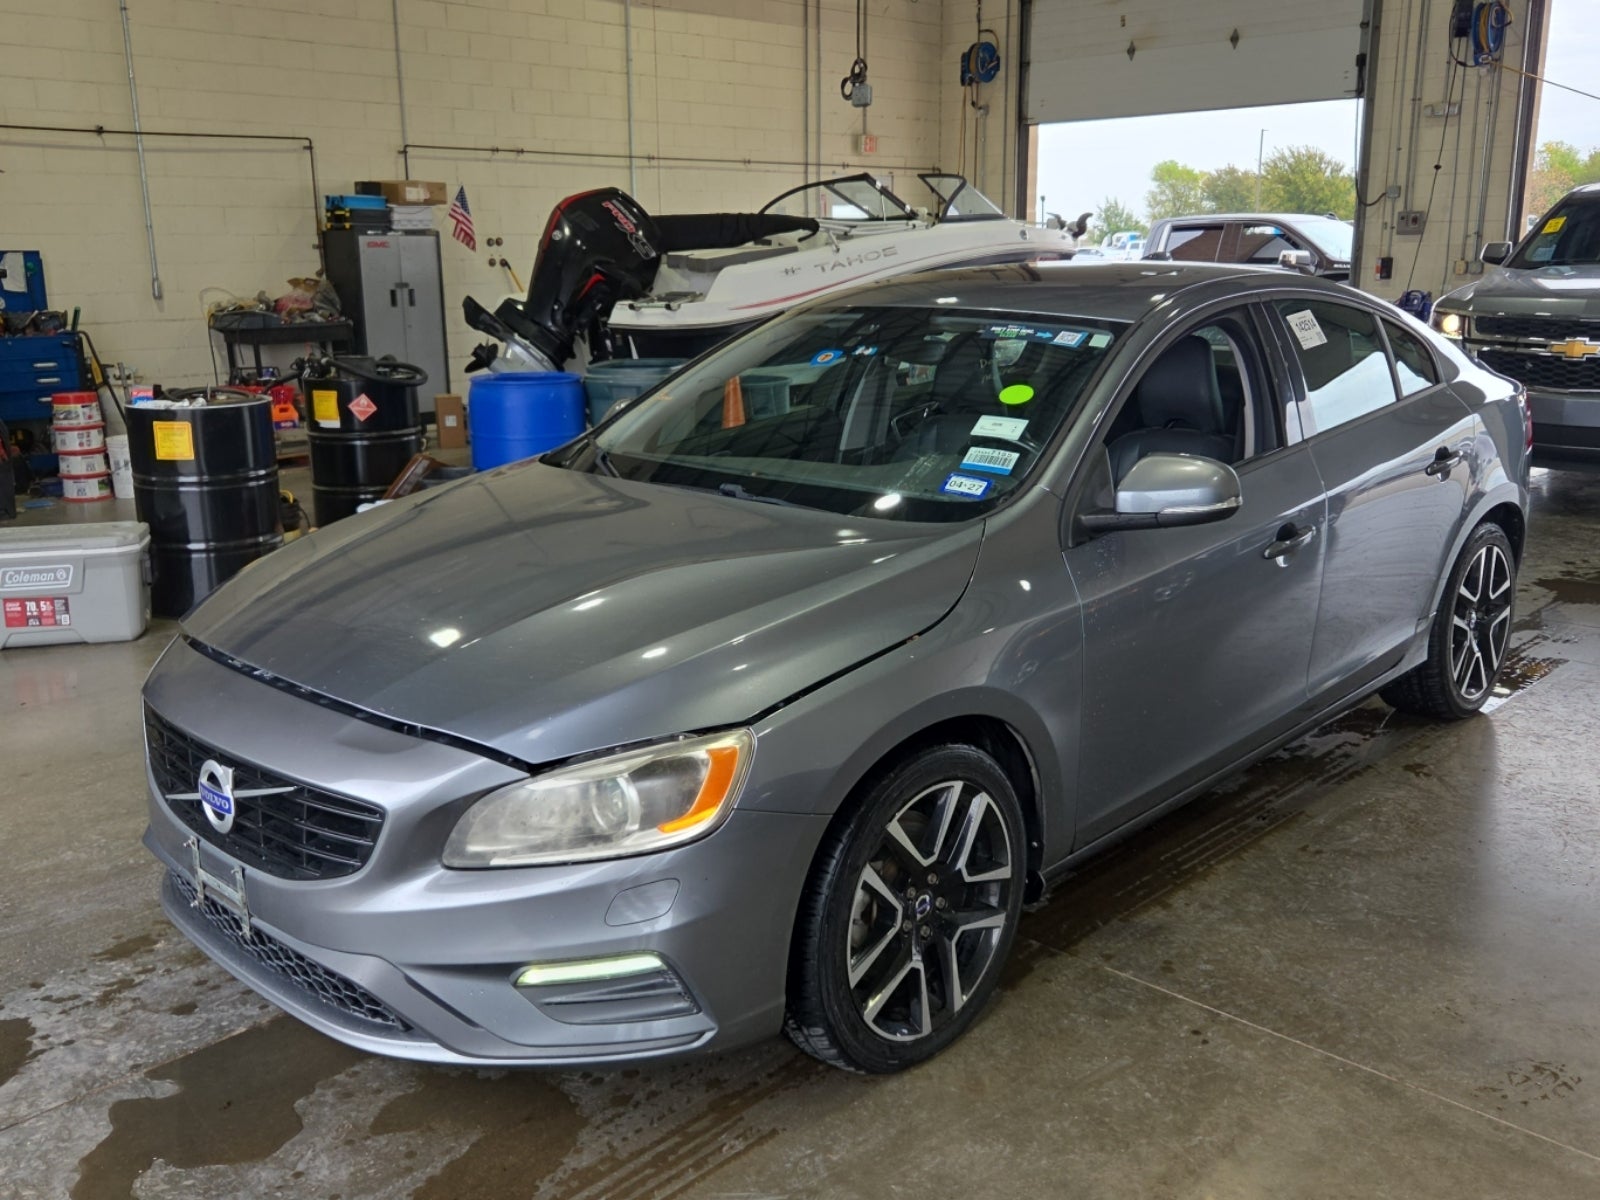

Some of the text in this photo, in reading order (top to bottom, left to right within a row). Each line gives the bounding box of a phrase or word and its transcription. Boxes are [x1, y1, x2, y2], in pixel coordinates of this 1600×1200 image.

[814, 245, 898, 273] TAHOE
[5, 570, 55, 584] Coleman
[201, 787, 229, 809] VOLVO
